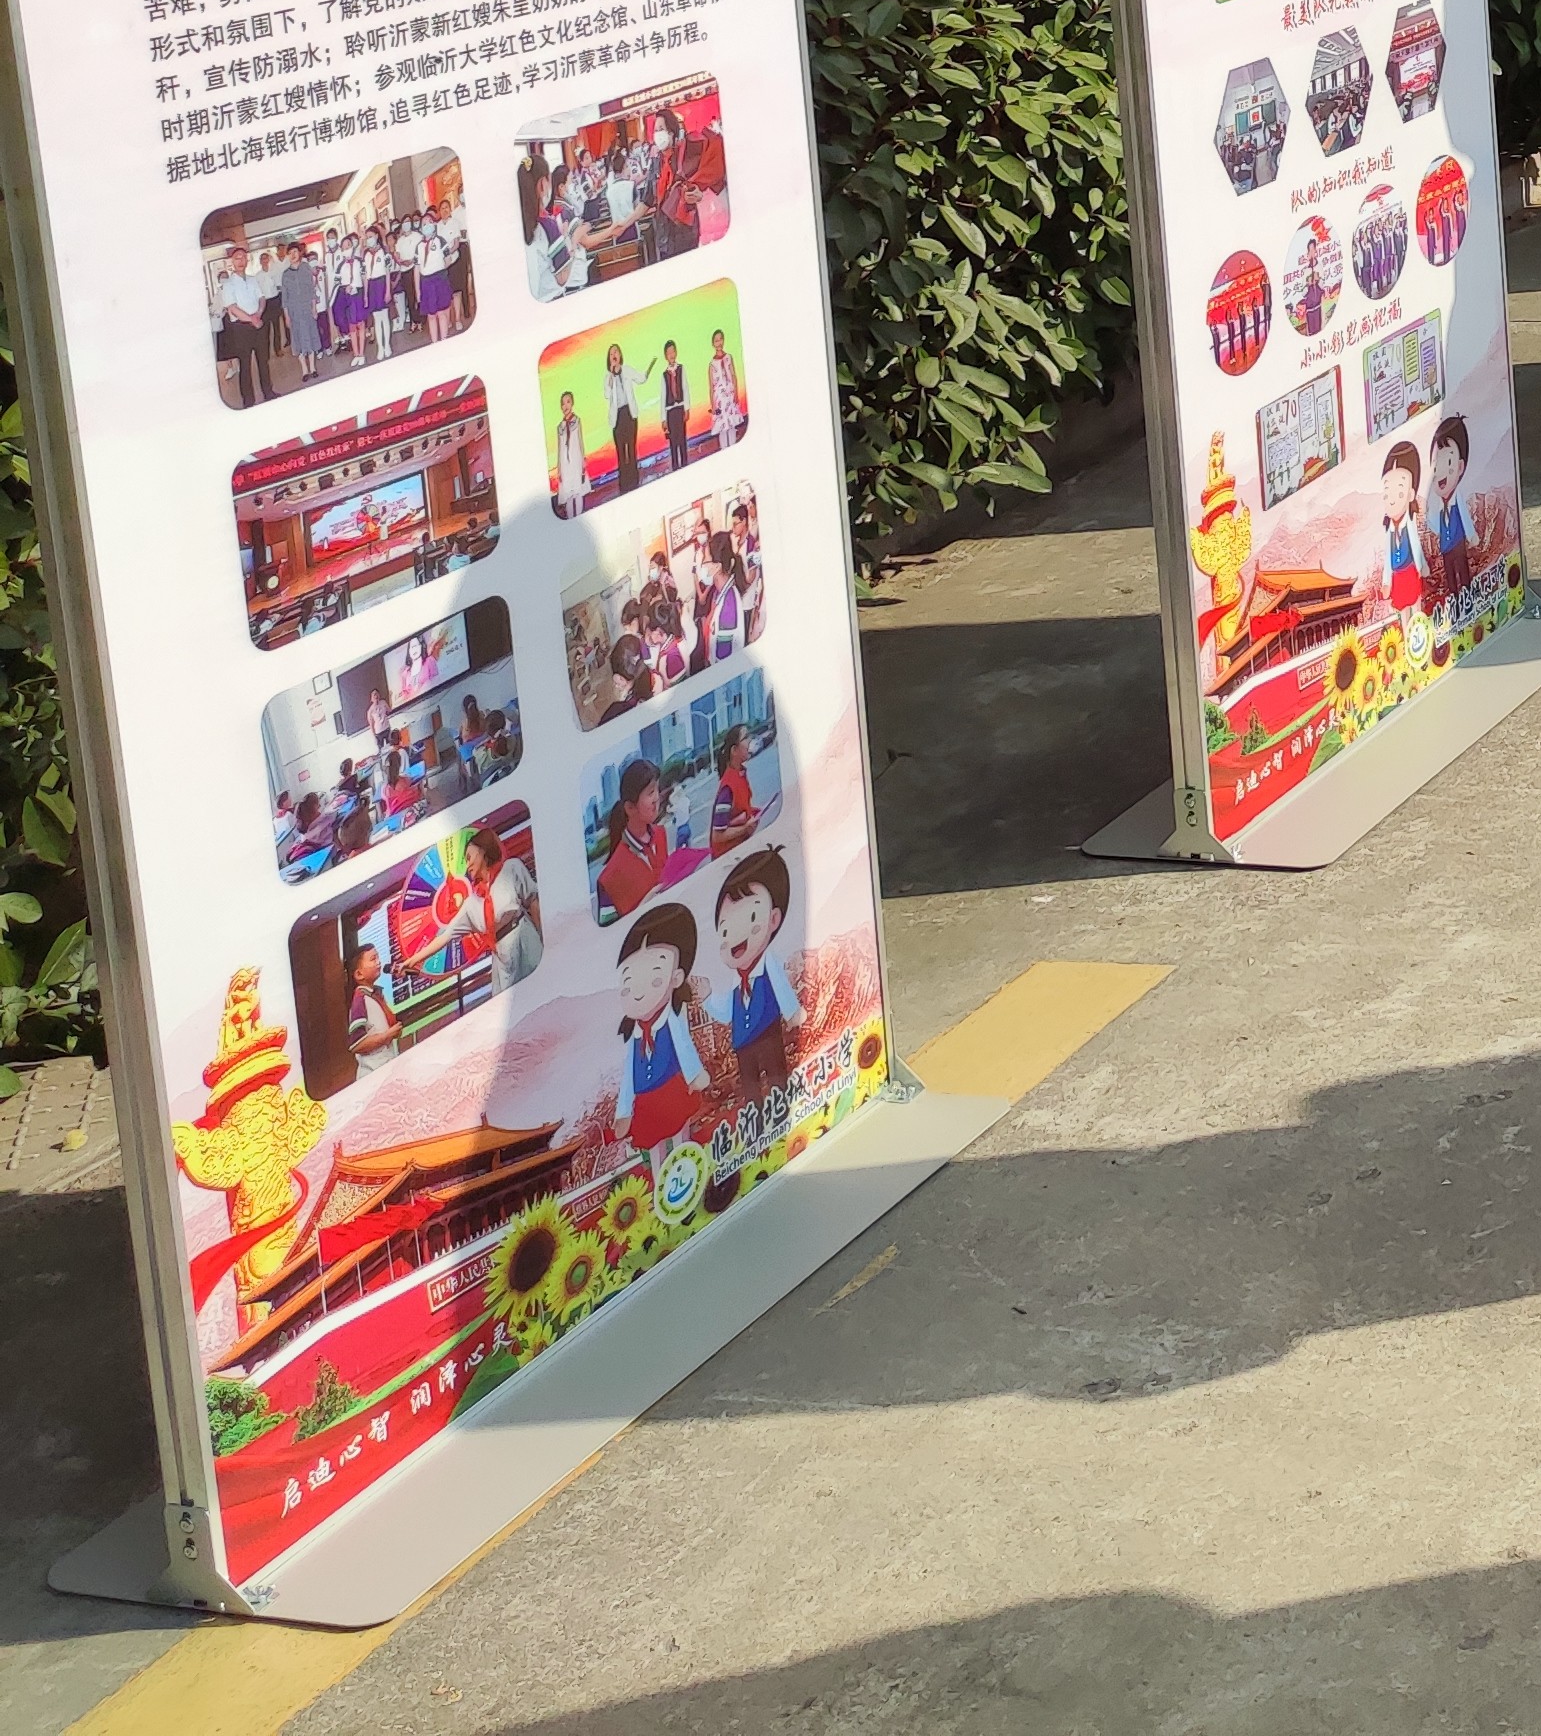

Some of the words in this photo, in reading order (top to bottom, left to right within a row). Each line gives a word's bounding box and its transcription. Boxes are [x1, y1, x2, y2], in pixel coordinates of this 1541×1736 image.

[711, 1027, 856, 1162] 临沂北城小学
[715, 1146, 757, 1183] Beicheng
[758, 1122, 791, 1148] Primary
[794, 1097, 824, 1120] School
[280, 1411, 391, 1519] 启迪心智
[409, 1322, 514, 1415] 润泽心灵
